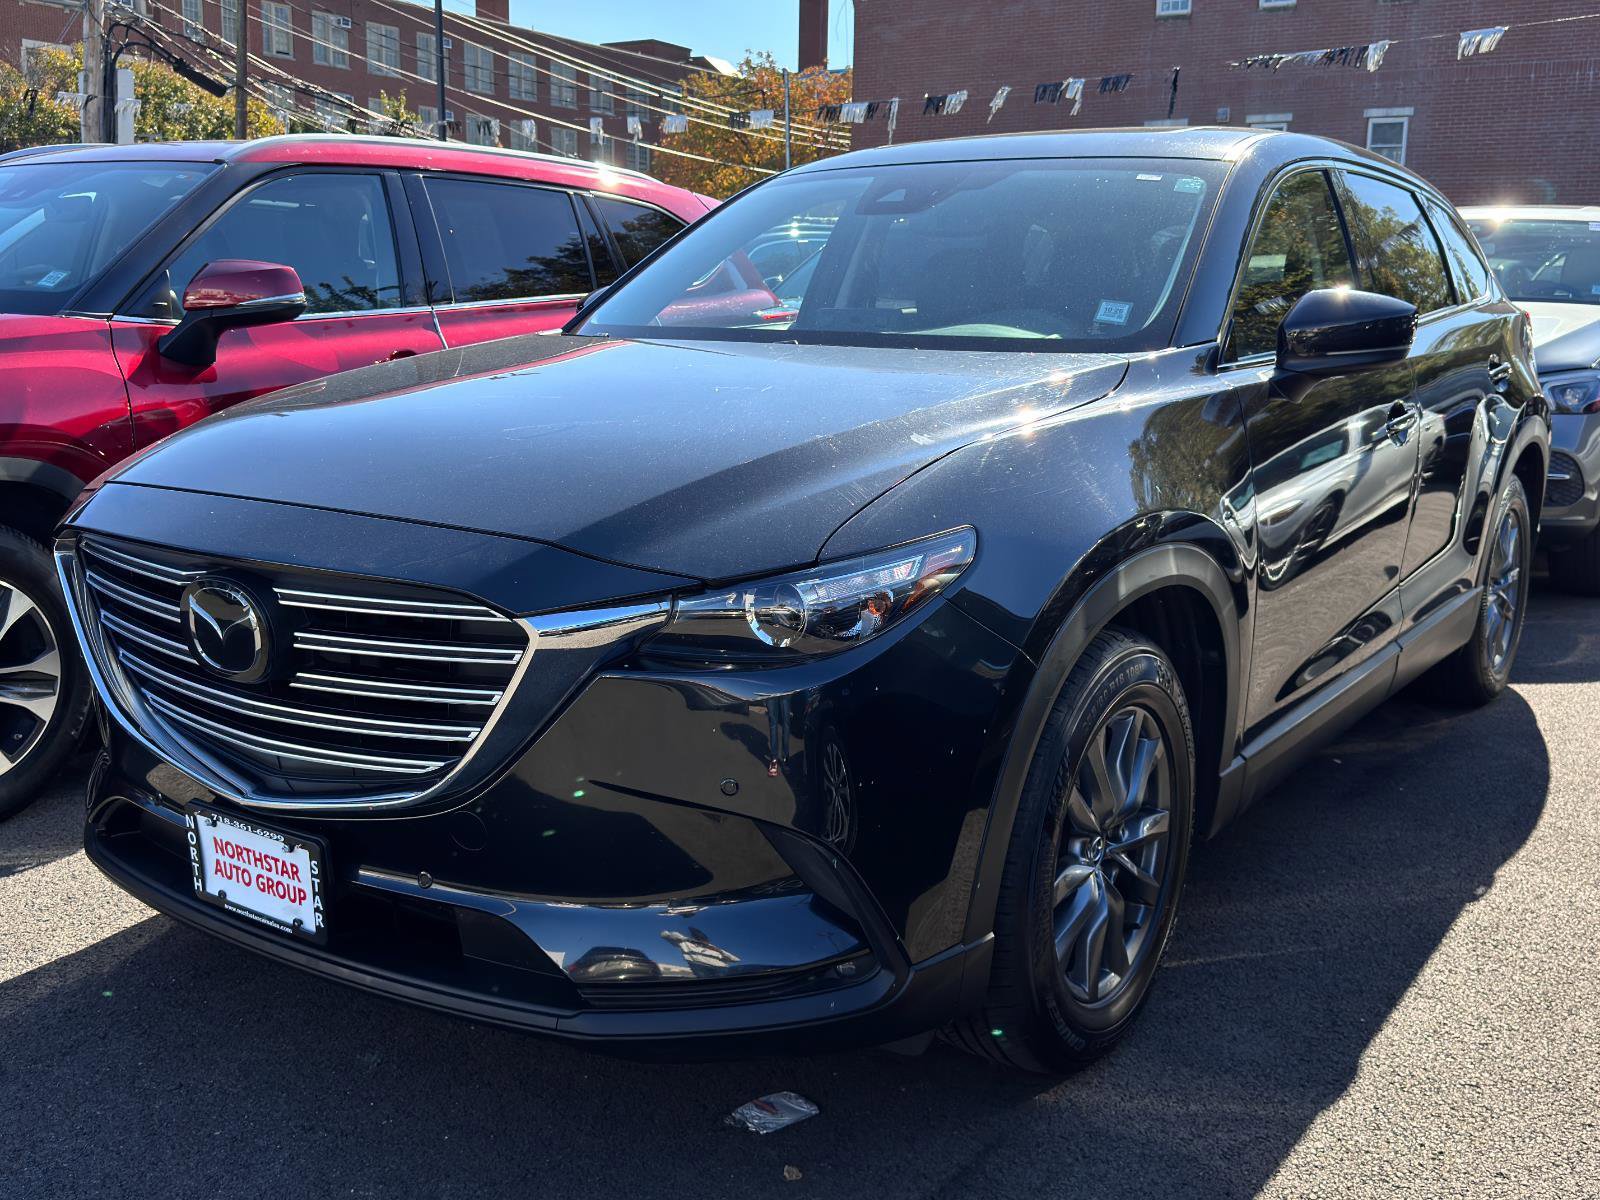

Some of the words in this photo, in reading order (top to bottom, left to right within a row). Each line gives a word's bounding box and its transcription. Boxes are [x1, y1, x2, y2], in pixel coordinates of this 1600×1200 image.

[211, 813, 285, 842] 718-361-6299
[185, 814, 203, 892] NORTH
[213, 836, 302, 883] NORTHSTAR
[214, 858, 252, 887] AUTO
[256, 874, 307, 906] GROUP
[311, 860, 325, 928] STAR
